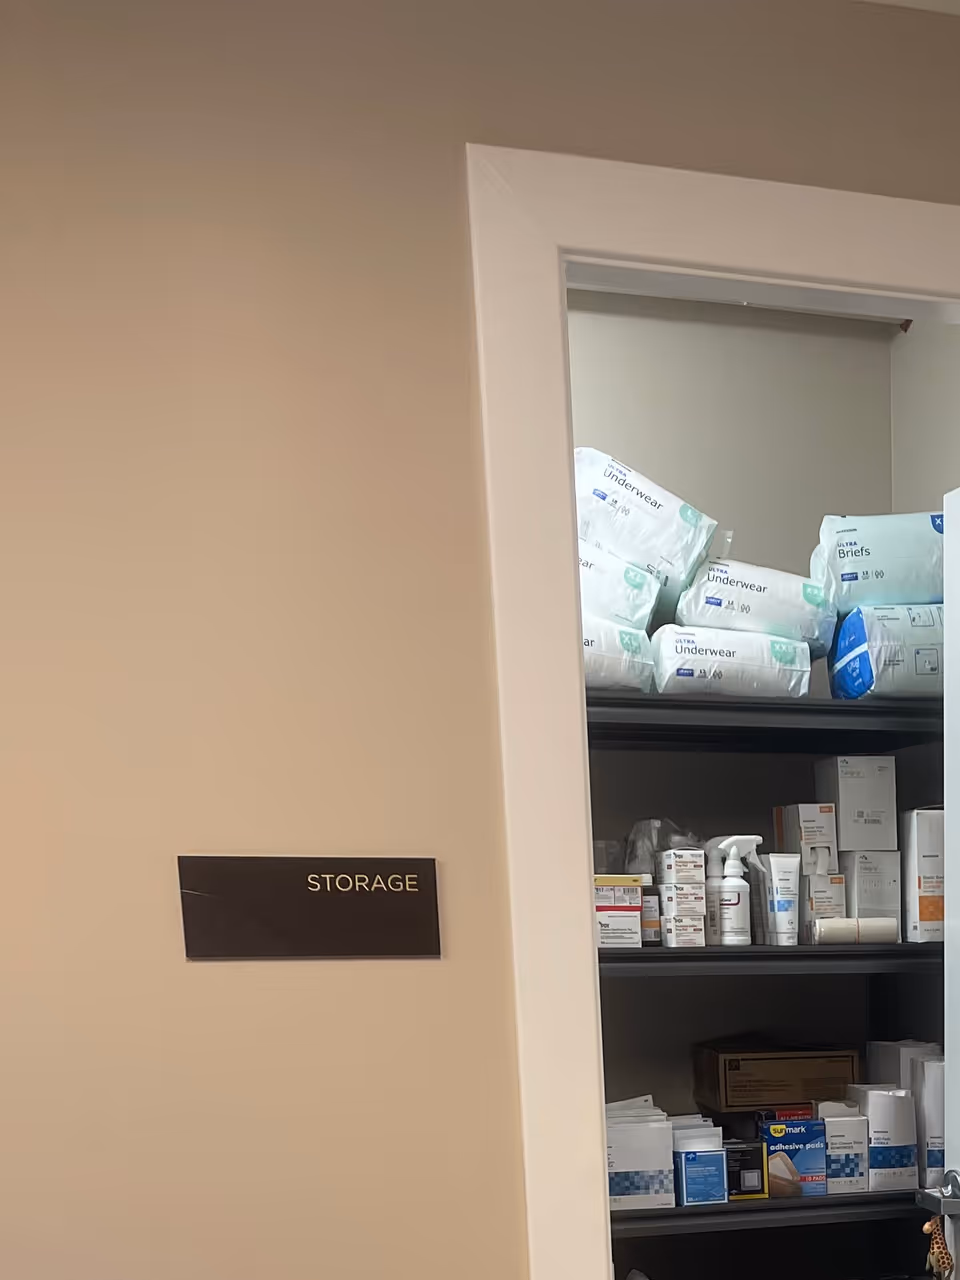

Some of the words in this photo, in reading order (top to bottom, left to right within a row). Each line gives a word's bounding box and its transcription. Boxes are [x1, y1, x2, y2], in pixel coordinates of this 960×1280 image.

[603, 468, 664, 510] Underwear
[838, 546, 870, 559] Briefs
[707, 572, 768, 593] Underwear
[675, 645, 736, 658] Underwear
[307, 874, 419, 892] STORAGE
[772, 1126, 806, 1134] sunmark
[770, 1142, 804, 1150] adhesive
[806, 1141, 824, 1150] pads
